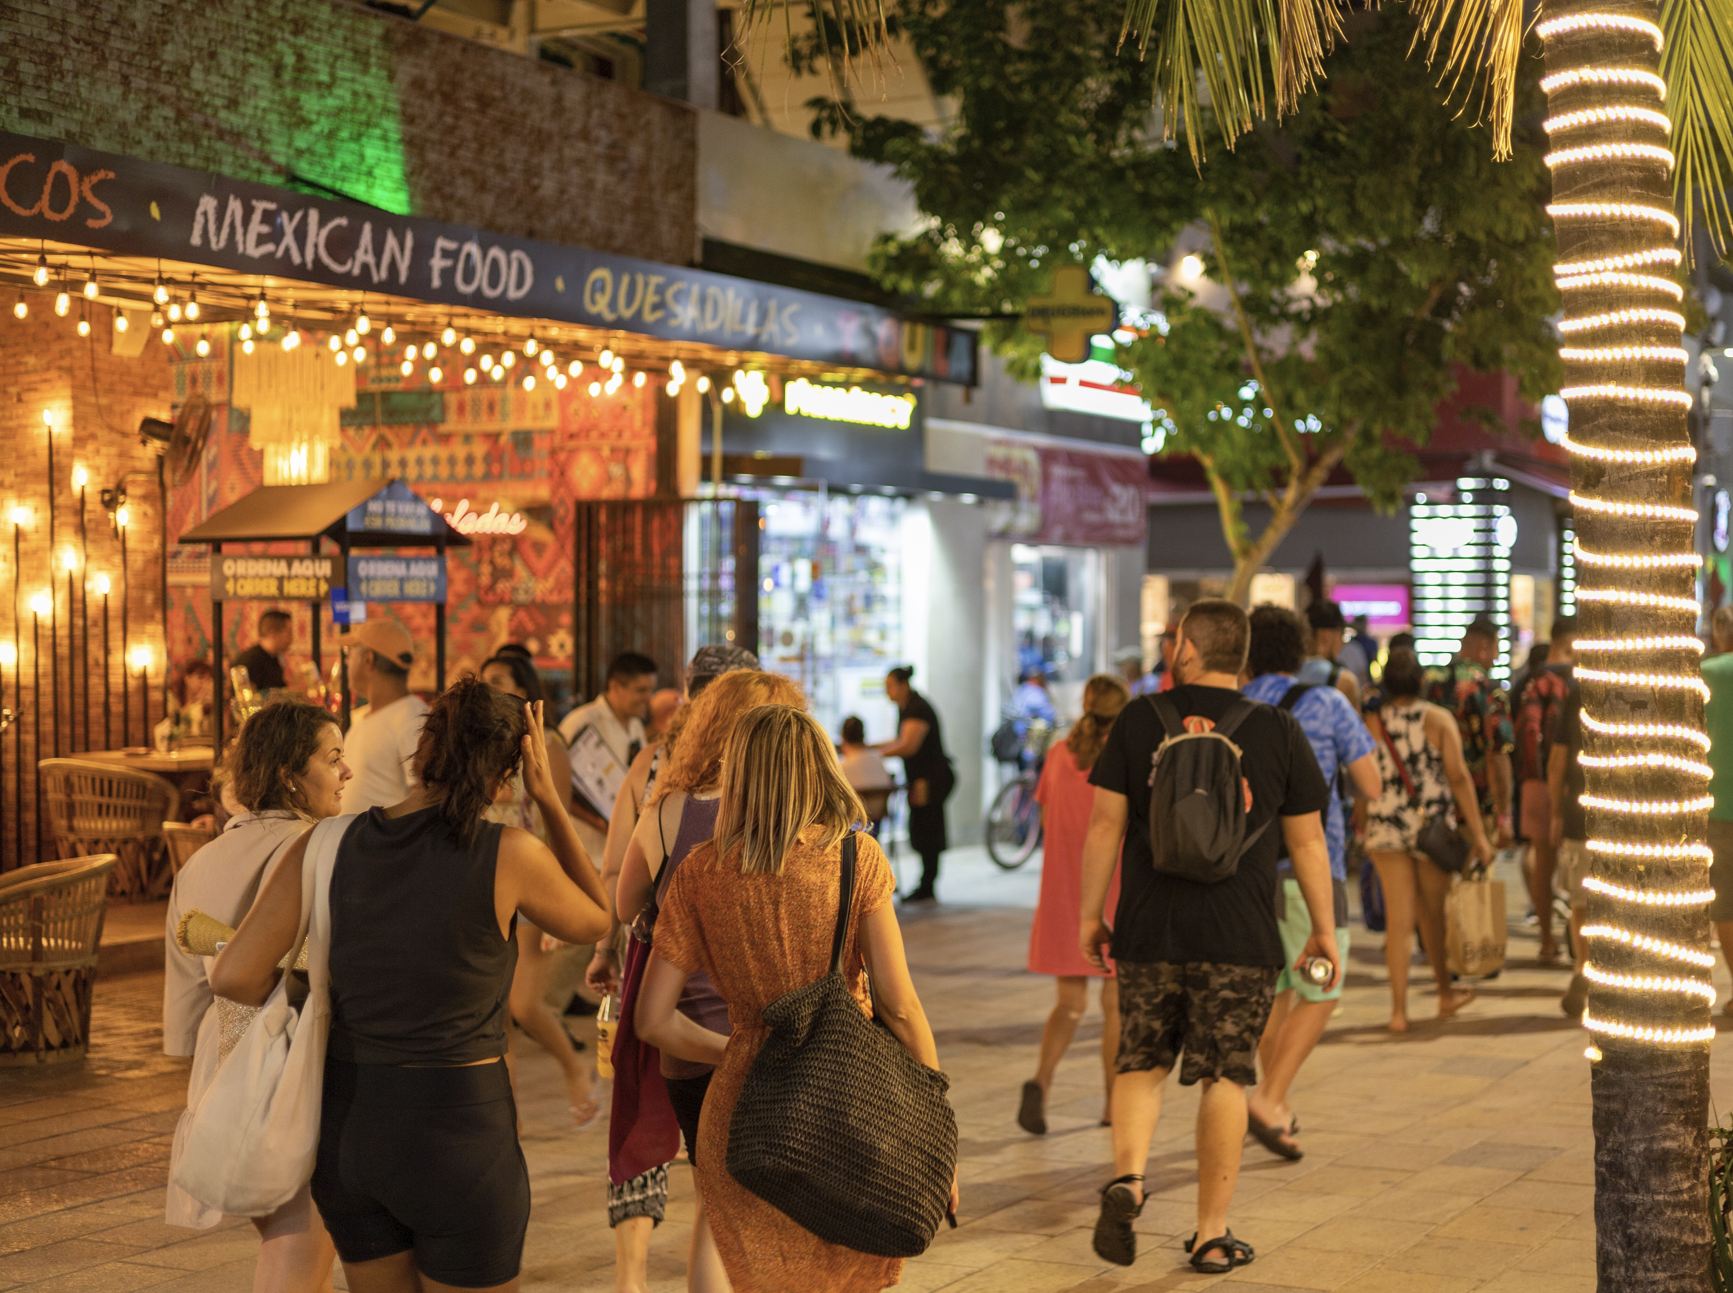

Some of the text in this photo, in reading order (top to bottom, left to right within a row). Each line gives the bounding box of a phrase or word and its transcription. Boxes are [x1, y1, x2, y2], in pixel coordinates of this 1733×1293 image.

[190, 193, 415, 285] MEXICAN
[430, 235, 535, 300] FOOD
[583, 266, 801, 347] QUESADILLAS
[283, 577, 317, 597] HERE
